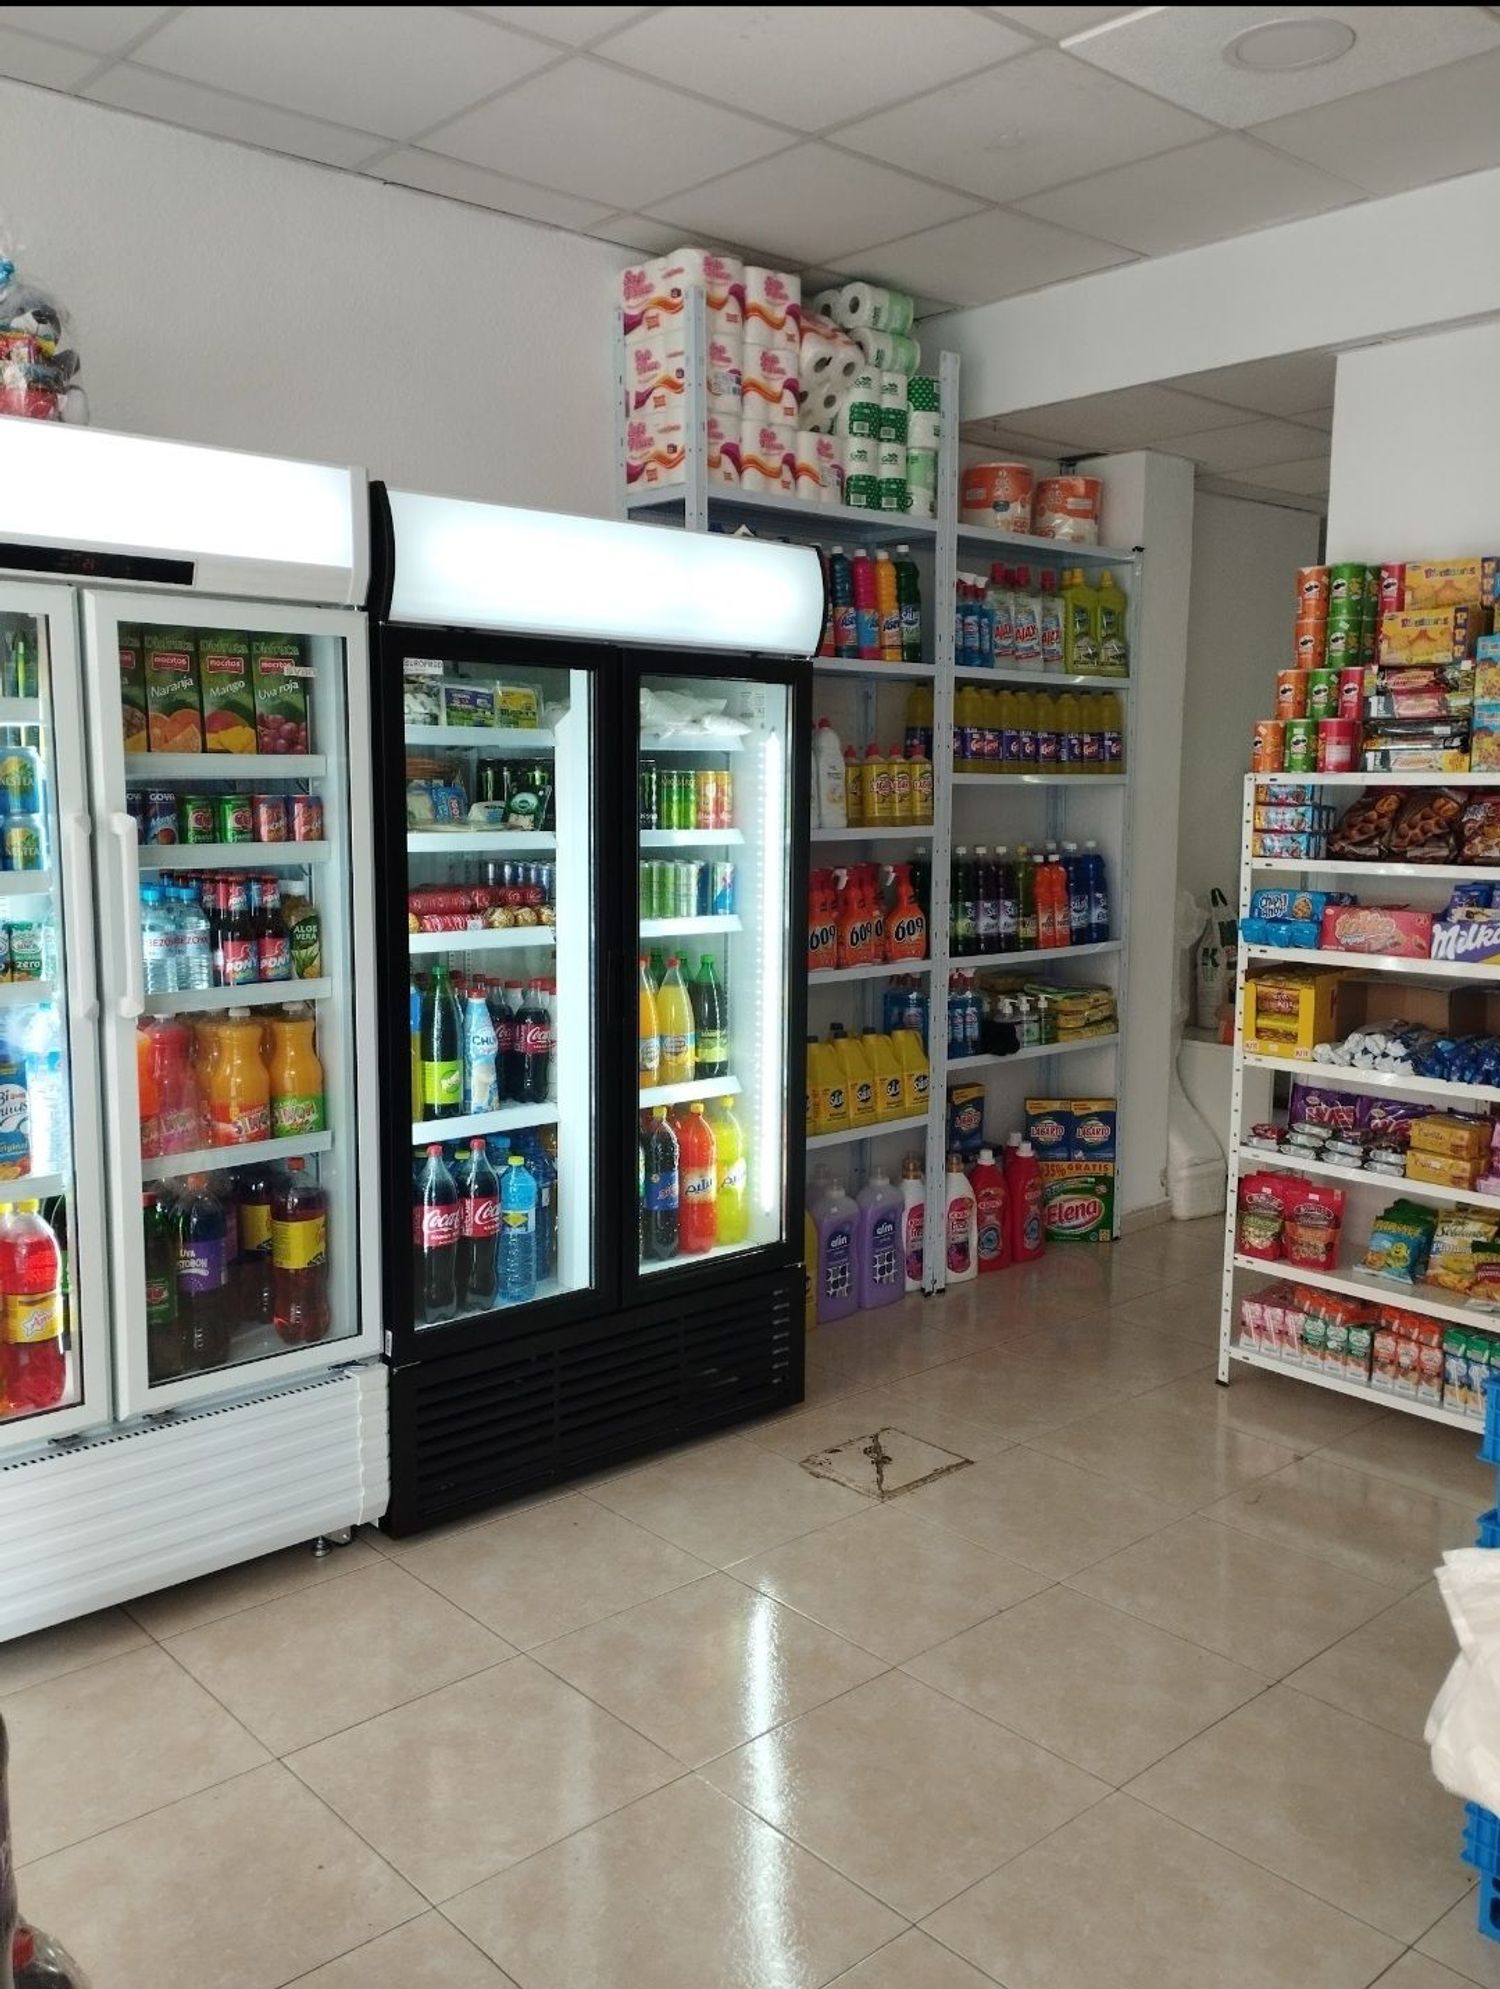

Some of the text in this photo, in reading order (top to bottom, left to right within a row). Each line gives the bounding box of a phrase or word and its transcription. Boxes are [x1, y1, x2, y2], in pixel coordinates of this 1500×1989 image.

[151, 675, 194, 698] Naranja
[209, 679, 246, 698] Mango
[258, 678, 300, 700] Uva roja
[150, 792, 175, 801] GOYA
[294, 925, 318, 933] ALOE
[895, 916, 924, 942] 609
[296, 933, 317, 941] VERA
[16, 958, 41, 969] zero
[1067, 1163, 1110, 1172] GRATIS
[1047, 1200, 1097, 1226] Elena
